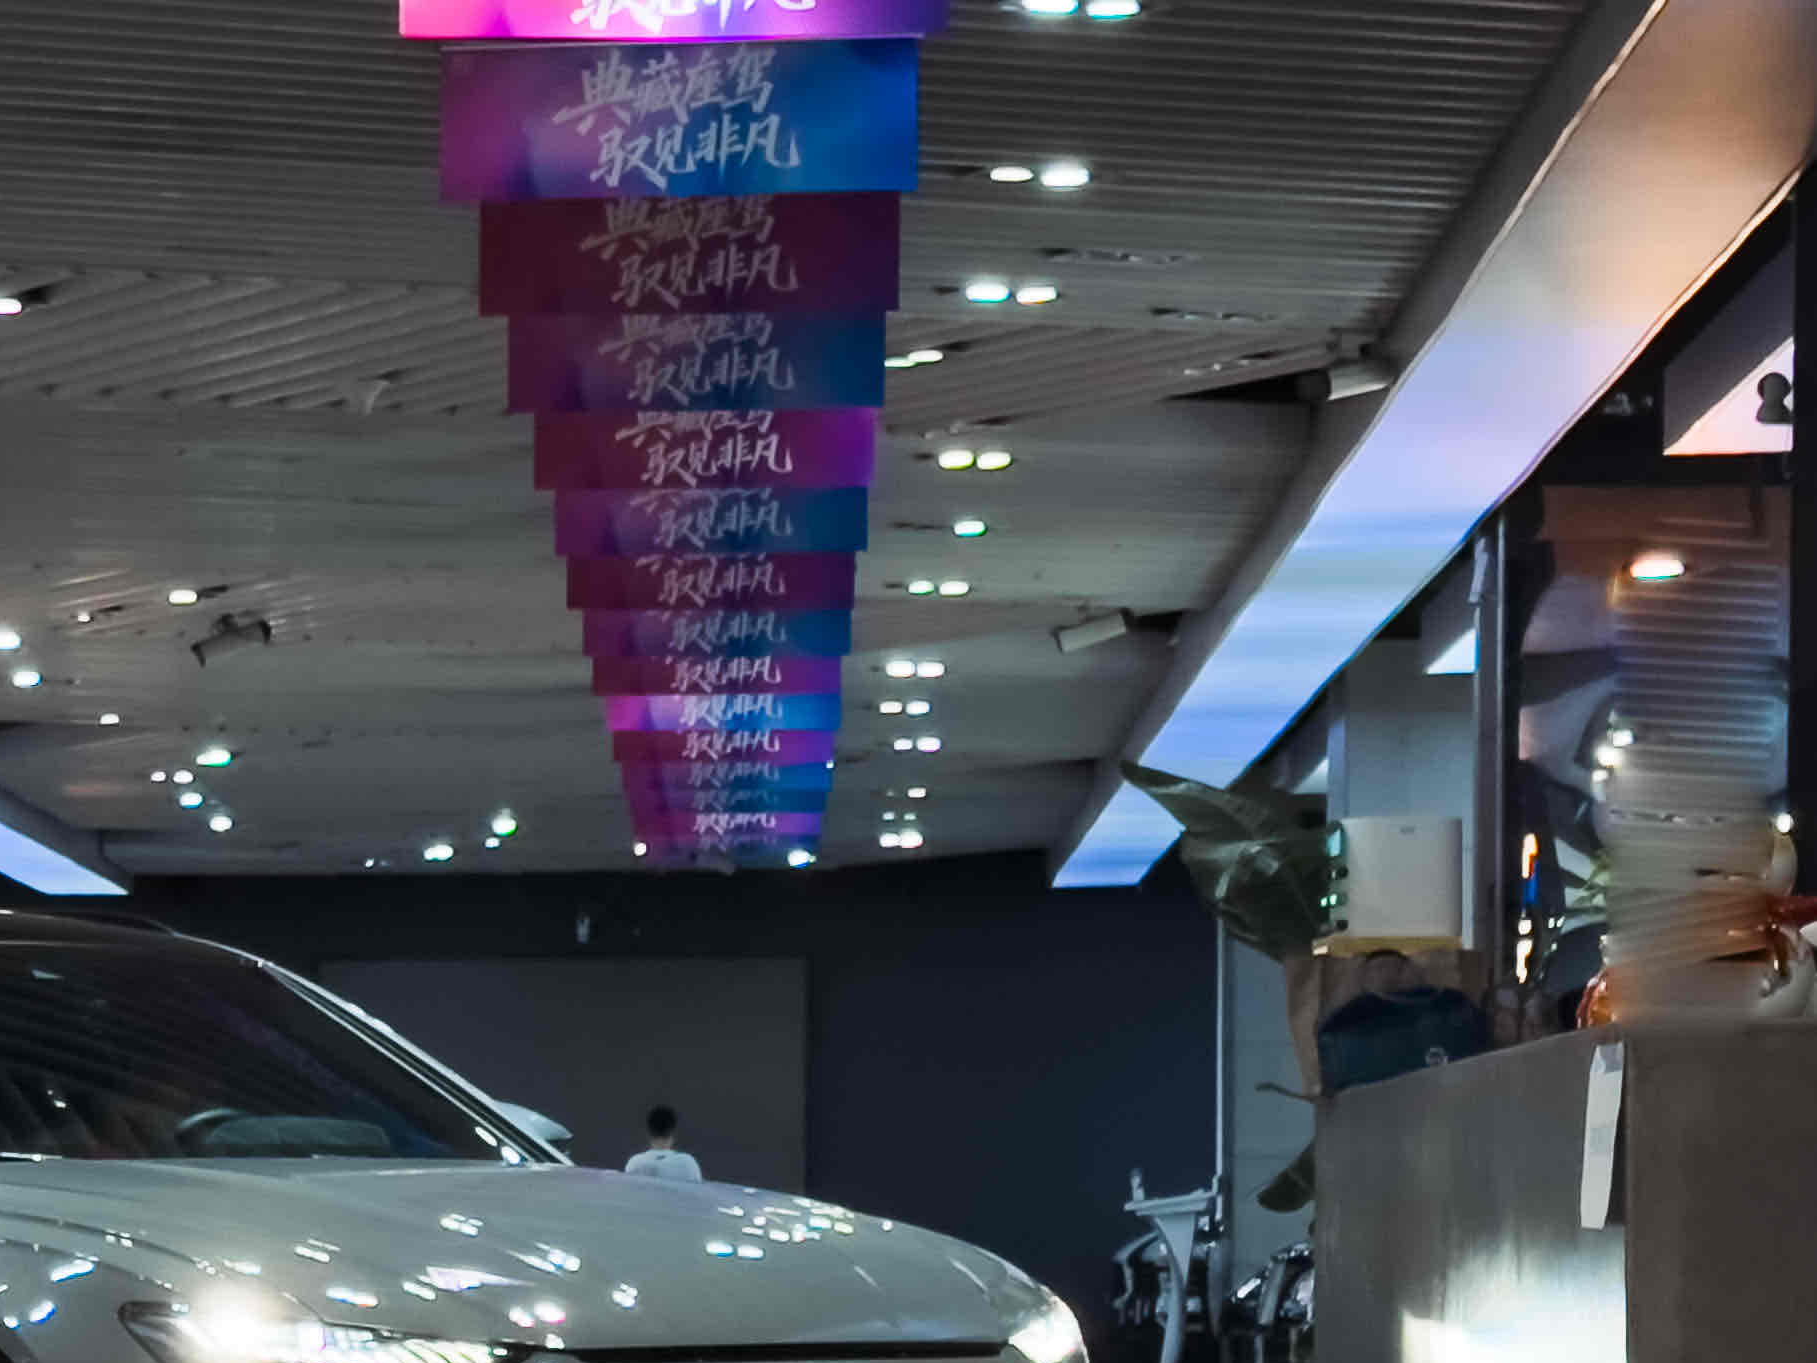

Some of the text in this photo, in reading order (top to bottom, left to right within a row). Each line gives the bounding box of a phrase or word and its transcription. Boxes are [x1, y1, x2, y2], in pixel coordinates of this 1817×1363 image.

[552, 45, 777, 134] 典藏座驾
[589, 115, 801, 189] 驭见非凡
[610, 244, 799, 308] 驭见非凡
[626, 348, 795, 405] 驭见非凡
[641, 434, 793, 486] 驭见非凡
